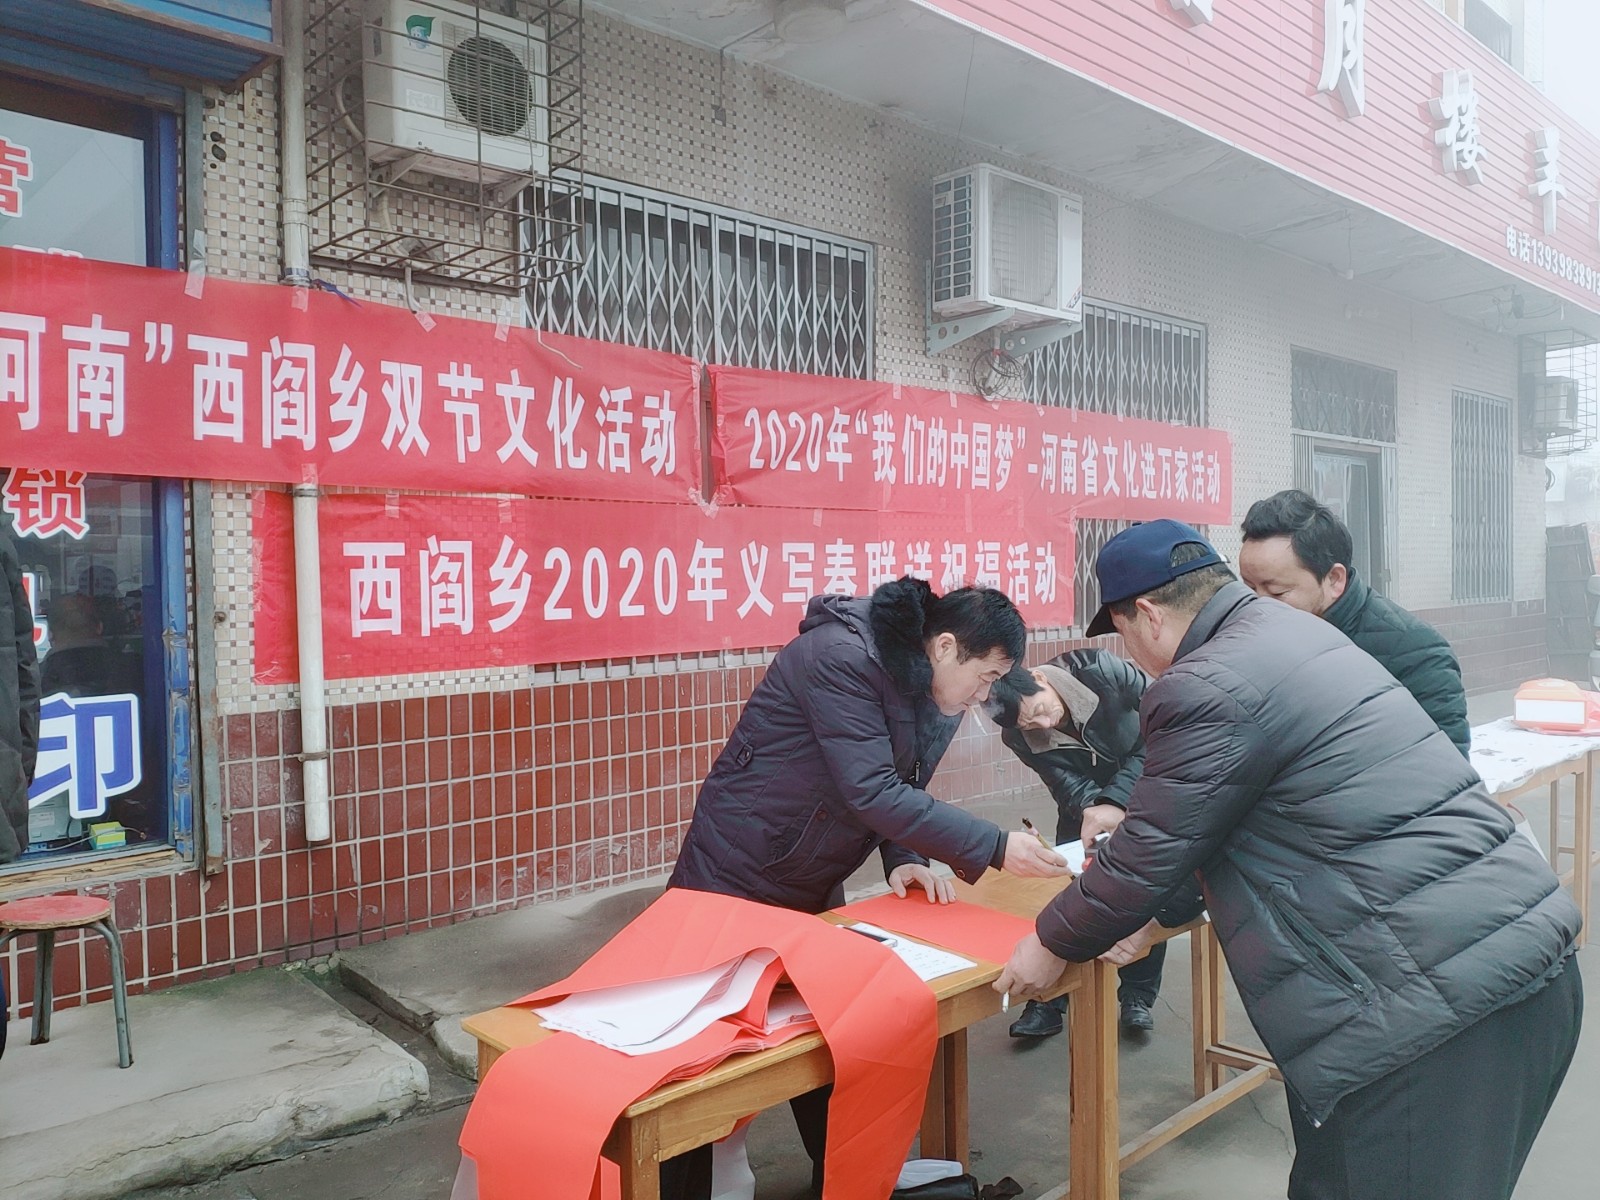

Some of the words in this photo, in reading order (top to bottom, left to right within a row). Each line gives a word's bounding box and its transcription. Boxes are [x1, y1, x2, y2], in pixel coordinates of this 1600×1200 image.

[4, 467, 89, 539] 锁
[342, 534, 1056, 638] 西阎乡2020年义写春联送祝福活动
[29, 693, 141, 818] 印
